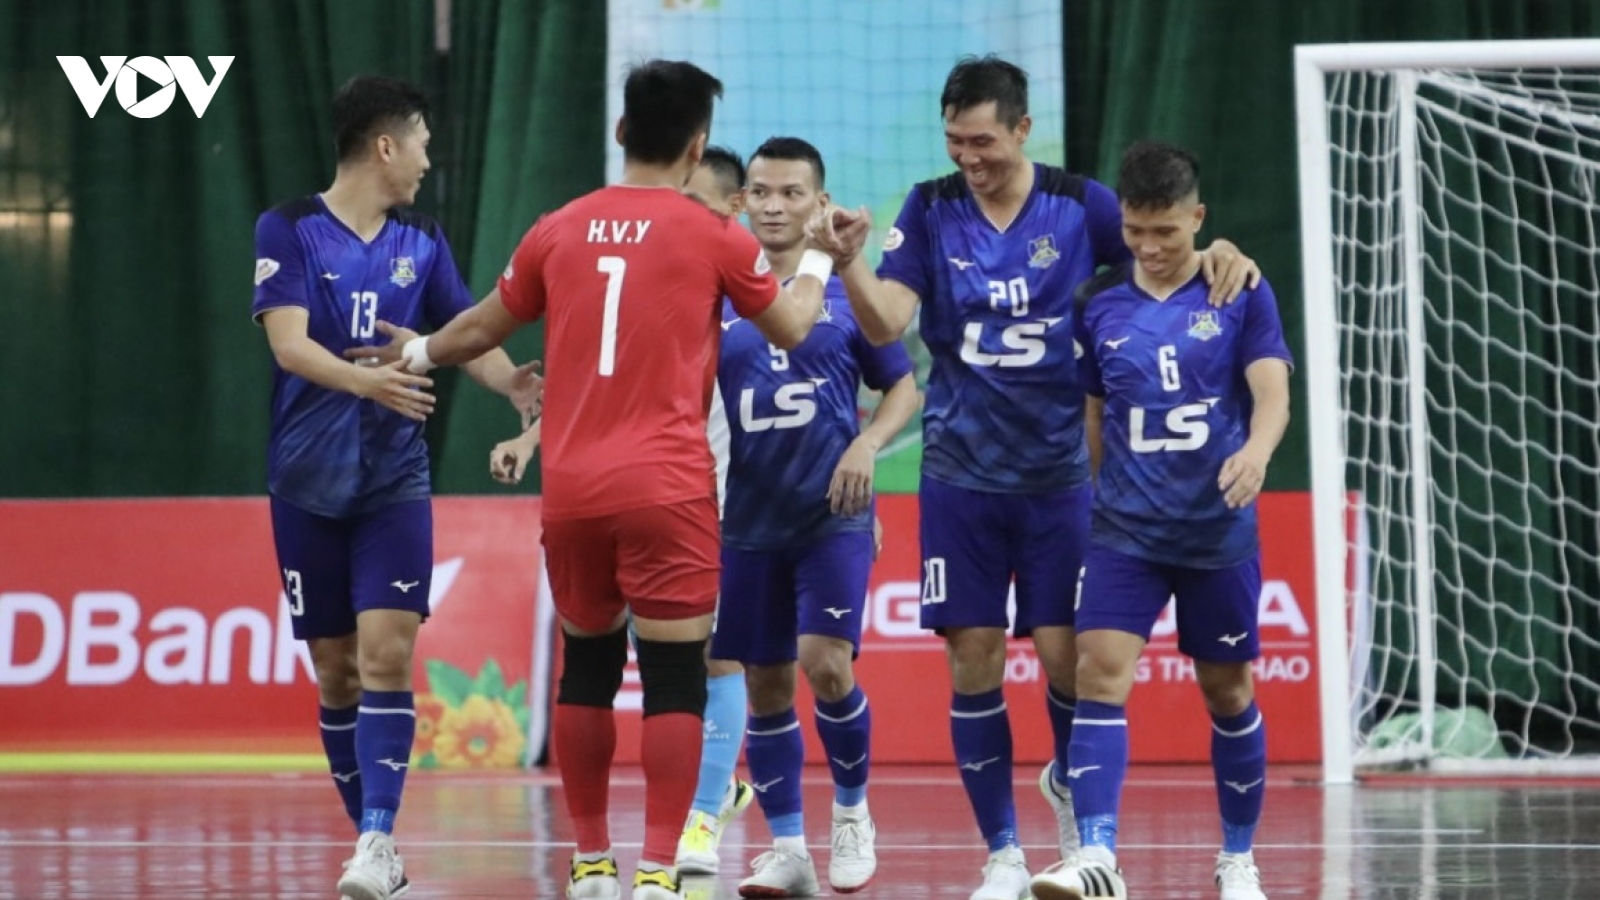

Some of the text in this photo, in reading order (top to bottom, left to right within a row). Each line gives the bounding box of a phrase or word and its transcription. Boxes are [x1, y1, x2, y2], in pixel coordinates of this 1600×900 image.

[587, 219, 651, 243] H.V.Y
[351, 291, 378, 338] 13
[597, 256, 626, 376] 1
[988, 277, 1029, 317] 20
[960, 320, 1046, 367] LS
[1158, 345, 1181, 392] 6
[740, 381, 817, 432] LS
[1129, 402, 1210, 453] LS
[284, 568, 304, 616] 3
[1250, 655, 1310, 681] HAO
